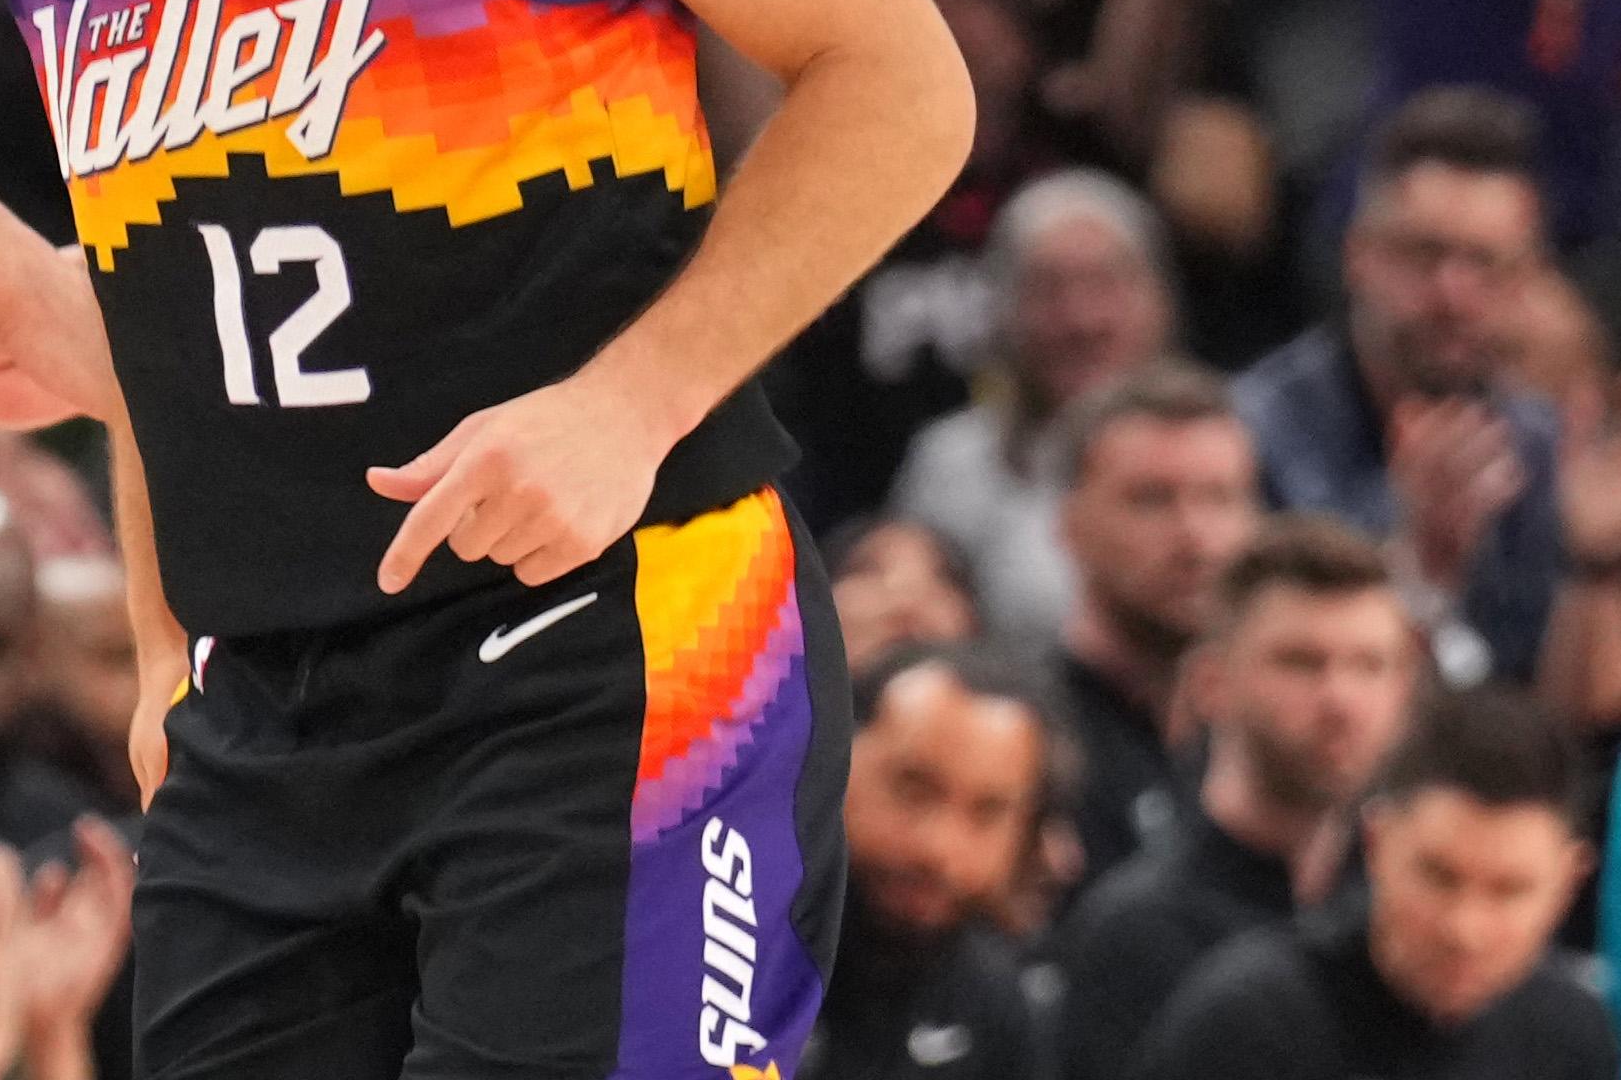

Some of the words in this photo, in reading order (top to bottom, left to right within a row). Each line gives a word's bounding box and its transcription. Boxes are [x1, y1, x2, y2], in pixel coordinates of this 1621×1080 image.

[88, 2, 152, 53] THE
[197, 223, 371, 408] 12
[699, 816, 768, 1069] SUNS
